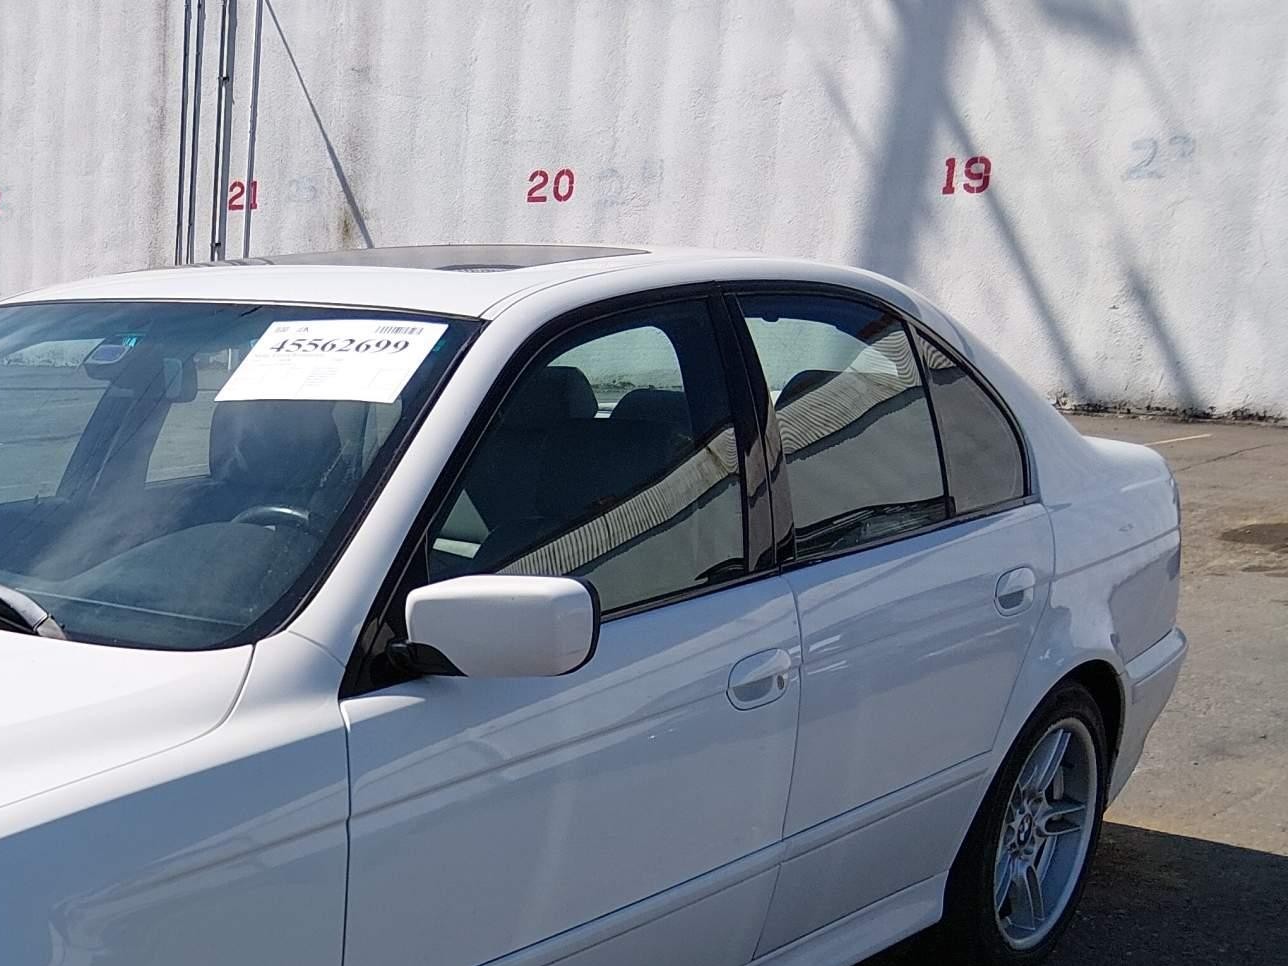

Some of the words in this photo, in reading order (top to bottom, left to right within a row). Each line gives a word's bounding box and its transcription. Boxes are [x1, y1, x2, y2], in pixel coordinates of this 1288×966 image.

[527, 168, 575, 204] 20
[942, 156, 992, 196] 19
[228, 181, 258, 211] 21
[270, 338, 410, 354] 45562699
